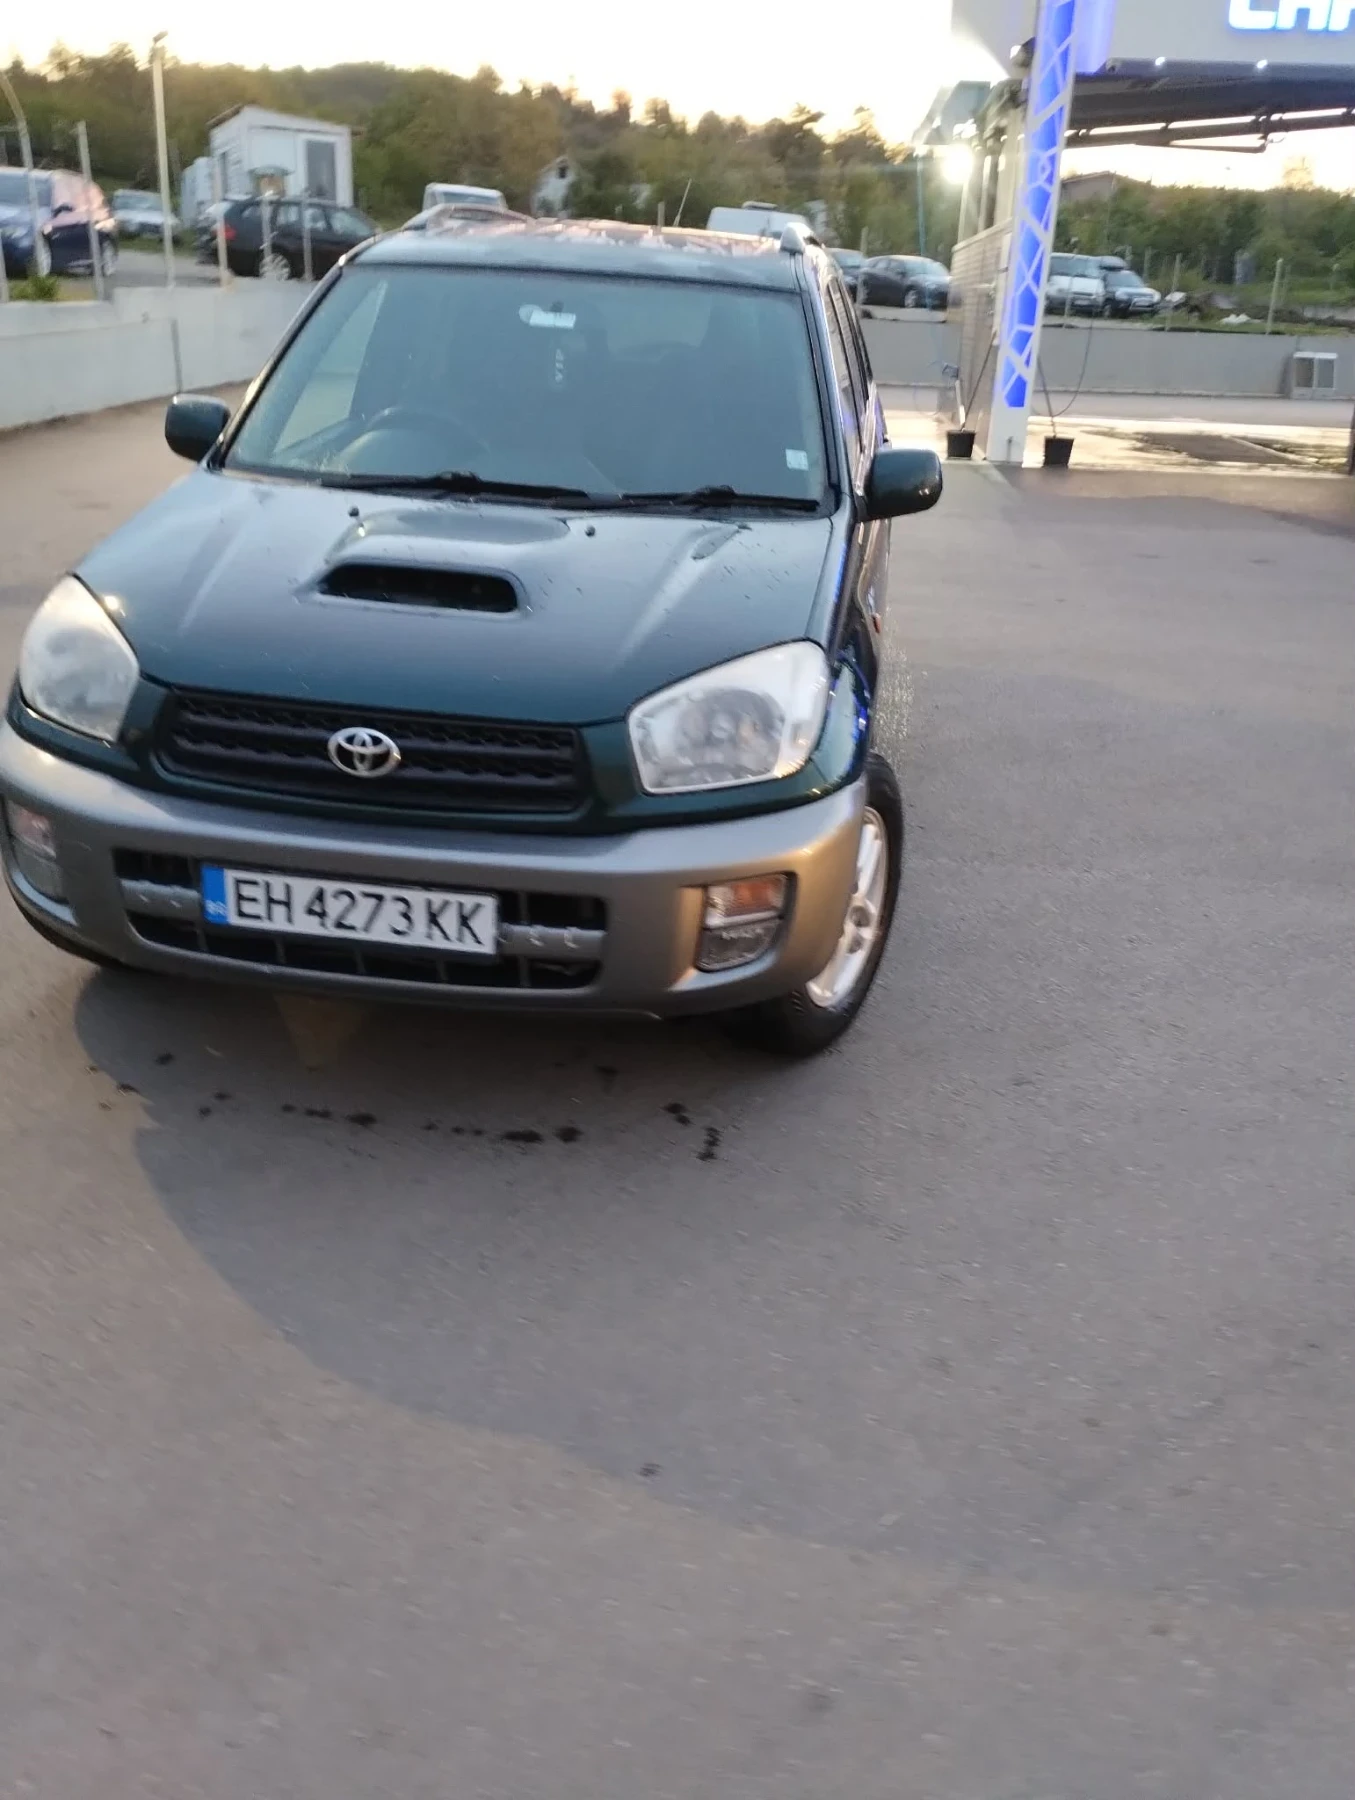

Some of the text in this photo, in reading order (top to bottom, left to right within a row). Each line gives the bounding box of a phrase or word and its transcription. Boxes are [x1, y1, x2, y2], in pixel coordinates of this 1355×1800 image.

[233, 877, 485, 946] EH 4273 KK
